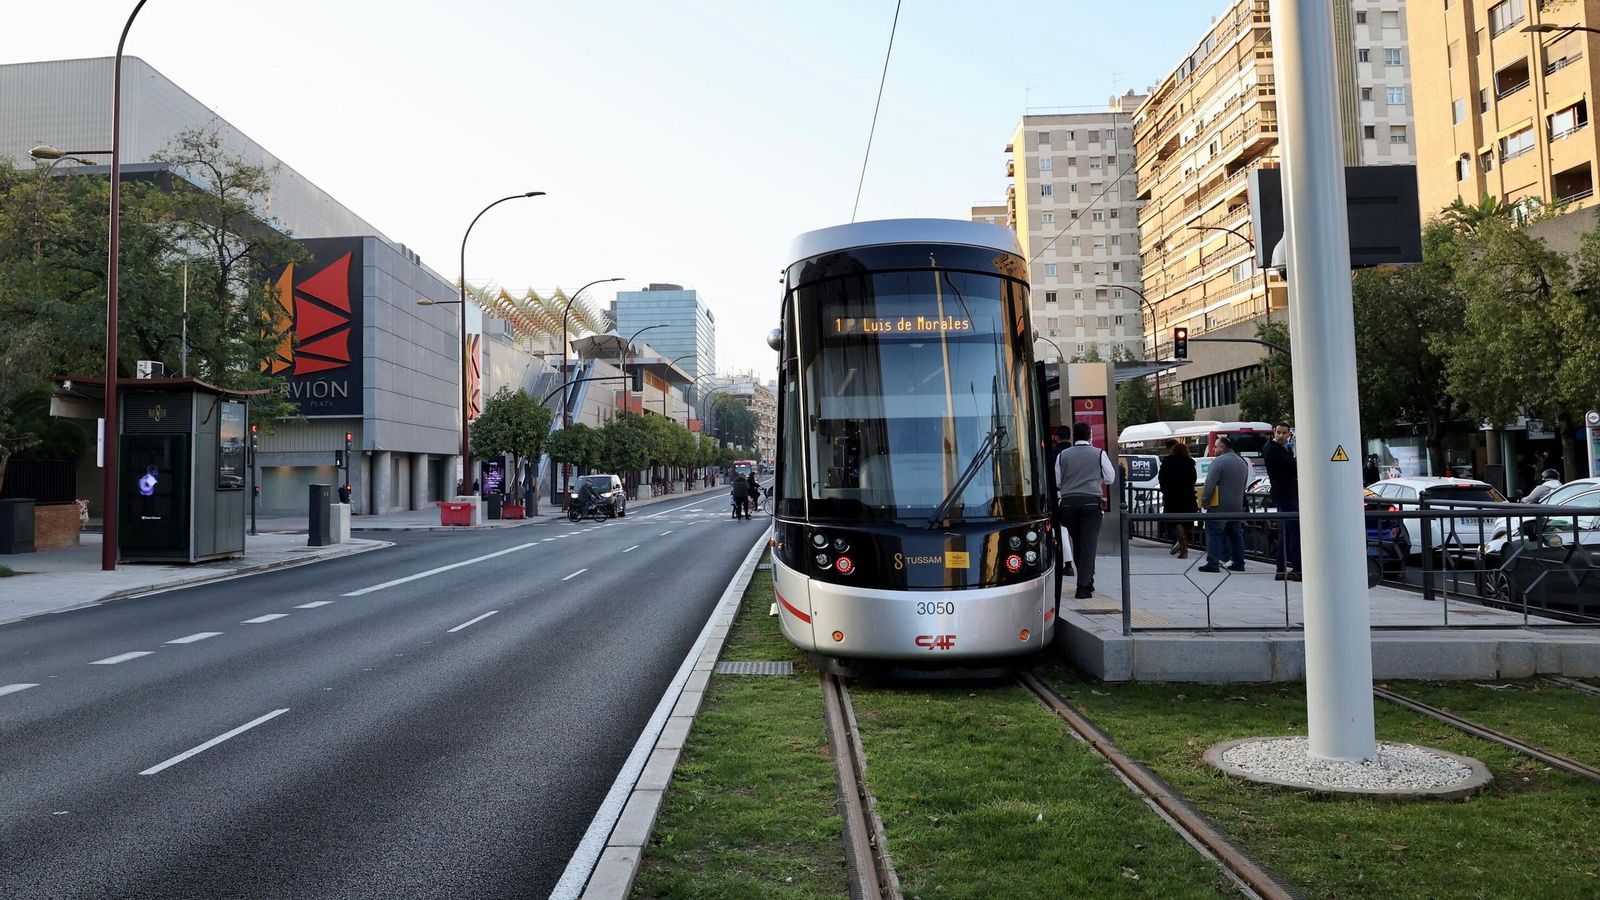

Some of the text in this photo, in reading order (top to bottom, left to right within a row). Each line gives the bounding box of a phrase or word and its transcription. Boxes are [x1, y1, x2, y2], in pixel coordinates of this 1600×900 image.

[863, 317, 892, 332] Luis
[897, 317, 912, 331] de
[916, 316, 969, 330] Morales
[274, 377, 348, 398] RVIÓN
[905, 556, 942, 564] TUSSAM
[917, 601, 955, 616] 3050
[915, 635, 956, 650] CAF
